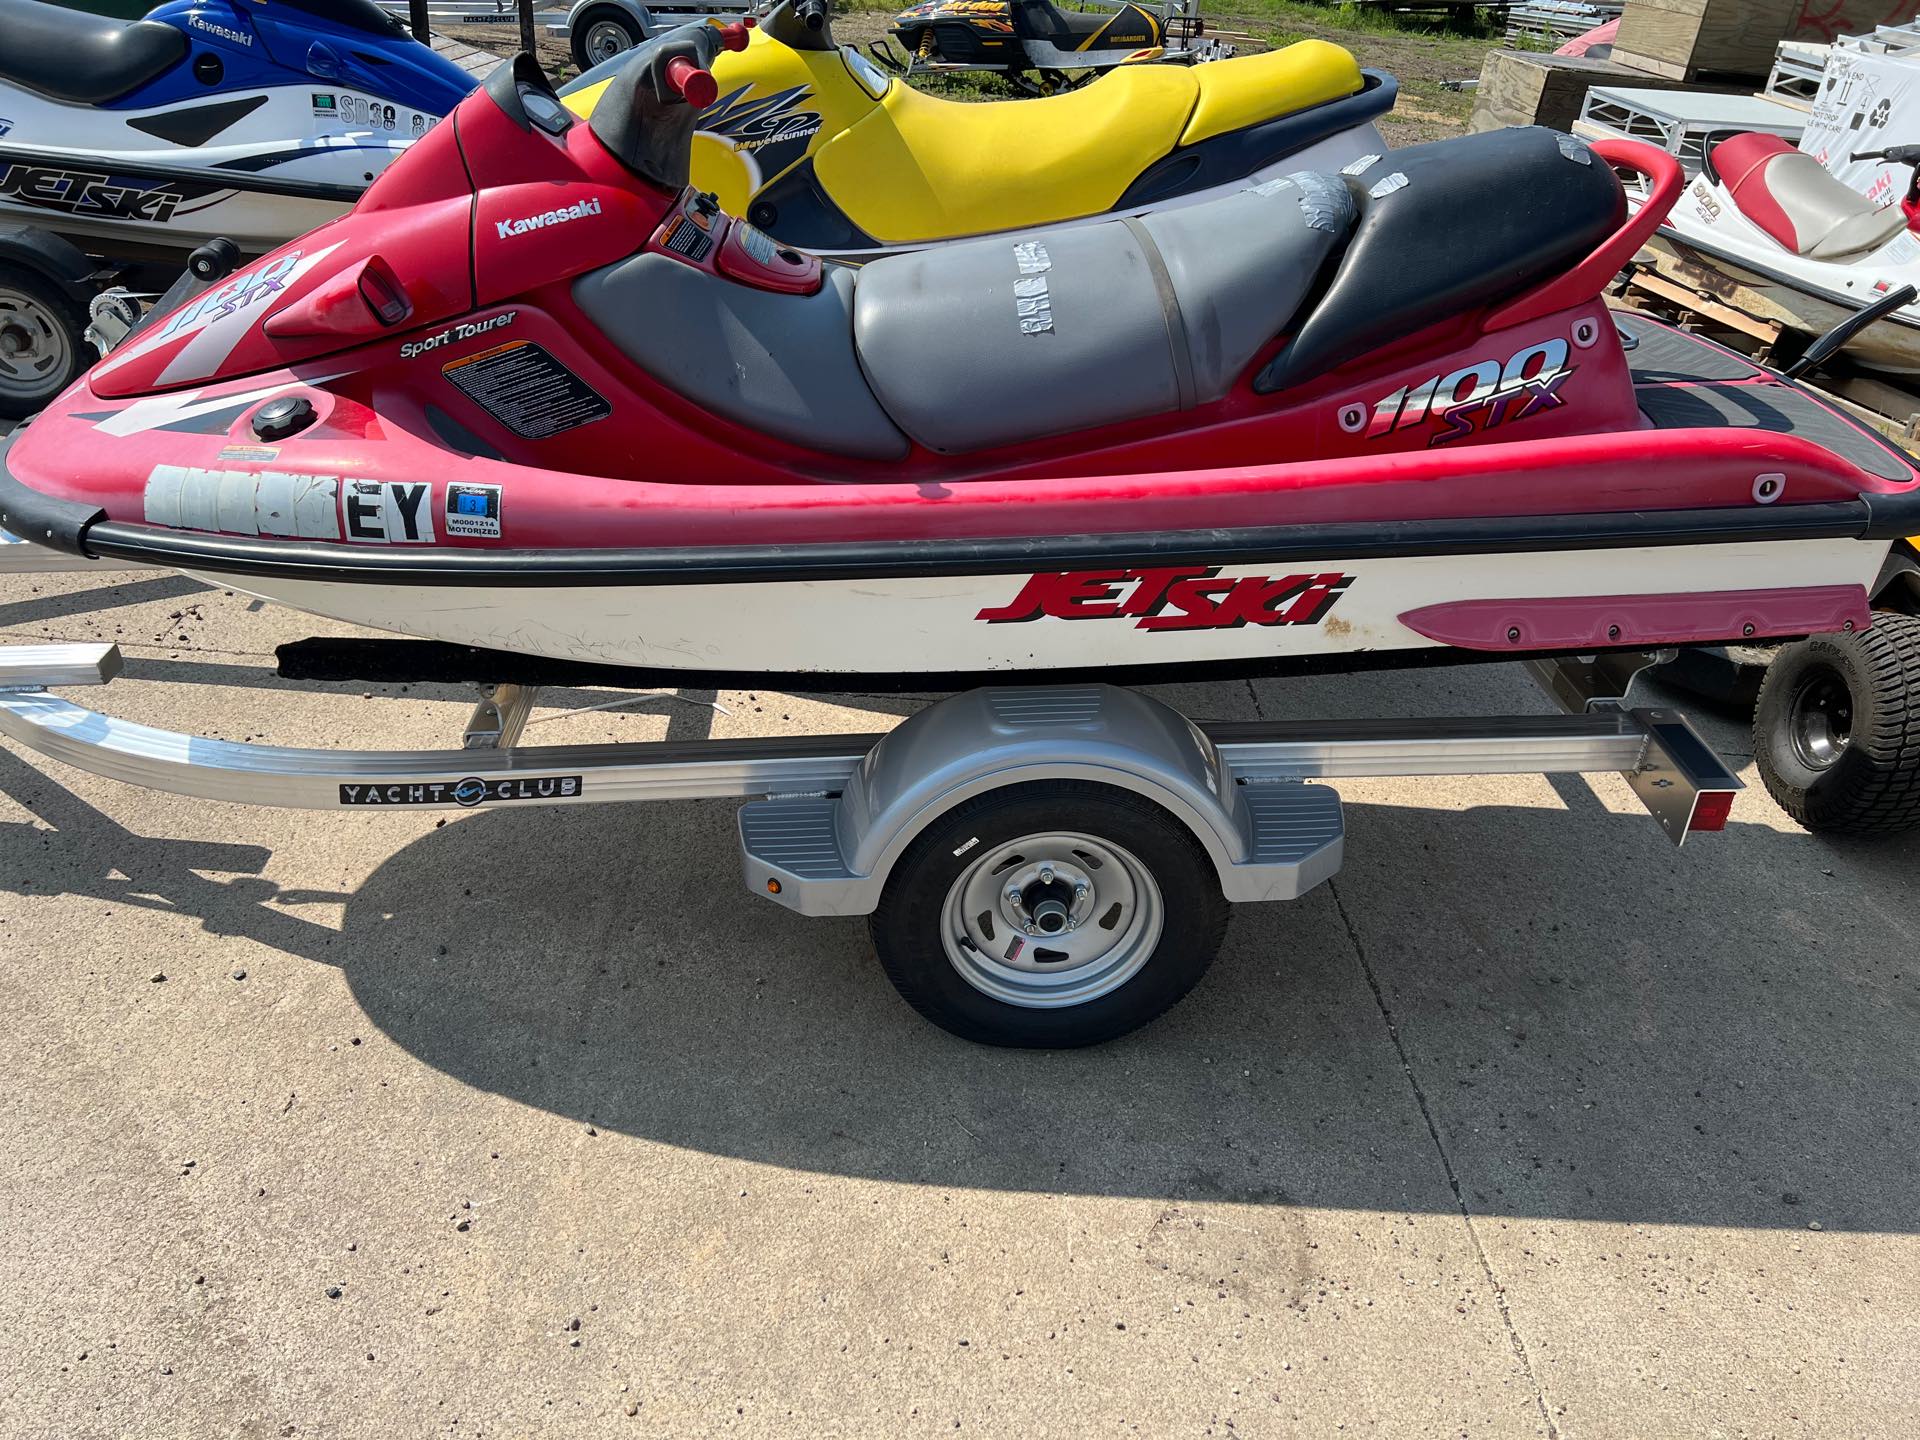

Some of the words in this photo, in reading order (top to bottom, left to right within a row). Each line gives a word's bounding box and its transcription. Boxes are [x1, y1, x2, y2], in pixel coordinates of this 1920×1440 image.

[188, 14, 253, 47] Kawasaki
[733, 125, 822, 153] WaveRunner
[495, 197, 602, 240] Kawasaki
[1692, 182, 1721, 218] 900
[211, 268, 294, 323] STX
[400, 329, 451, 359] Sport
[453, 310, 517, 342] Tourer
[1364, 337, 1570, 440] 1100
[1427, 365, 1581, 449] STX
[448, 526, 499, 536] MOTORIZED
[344, 784, 445, 804] YACHT
[496, 777, 576, 799] CLUB
